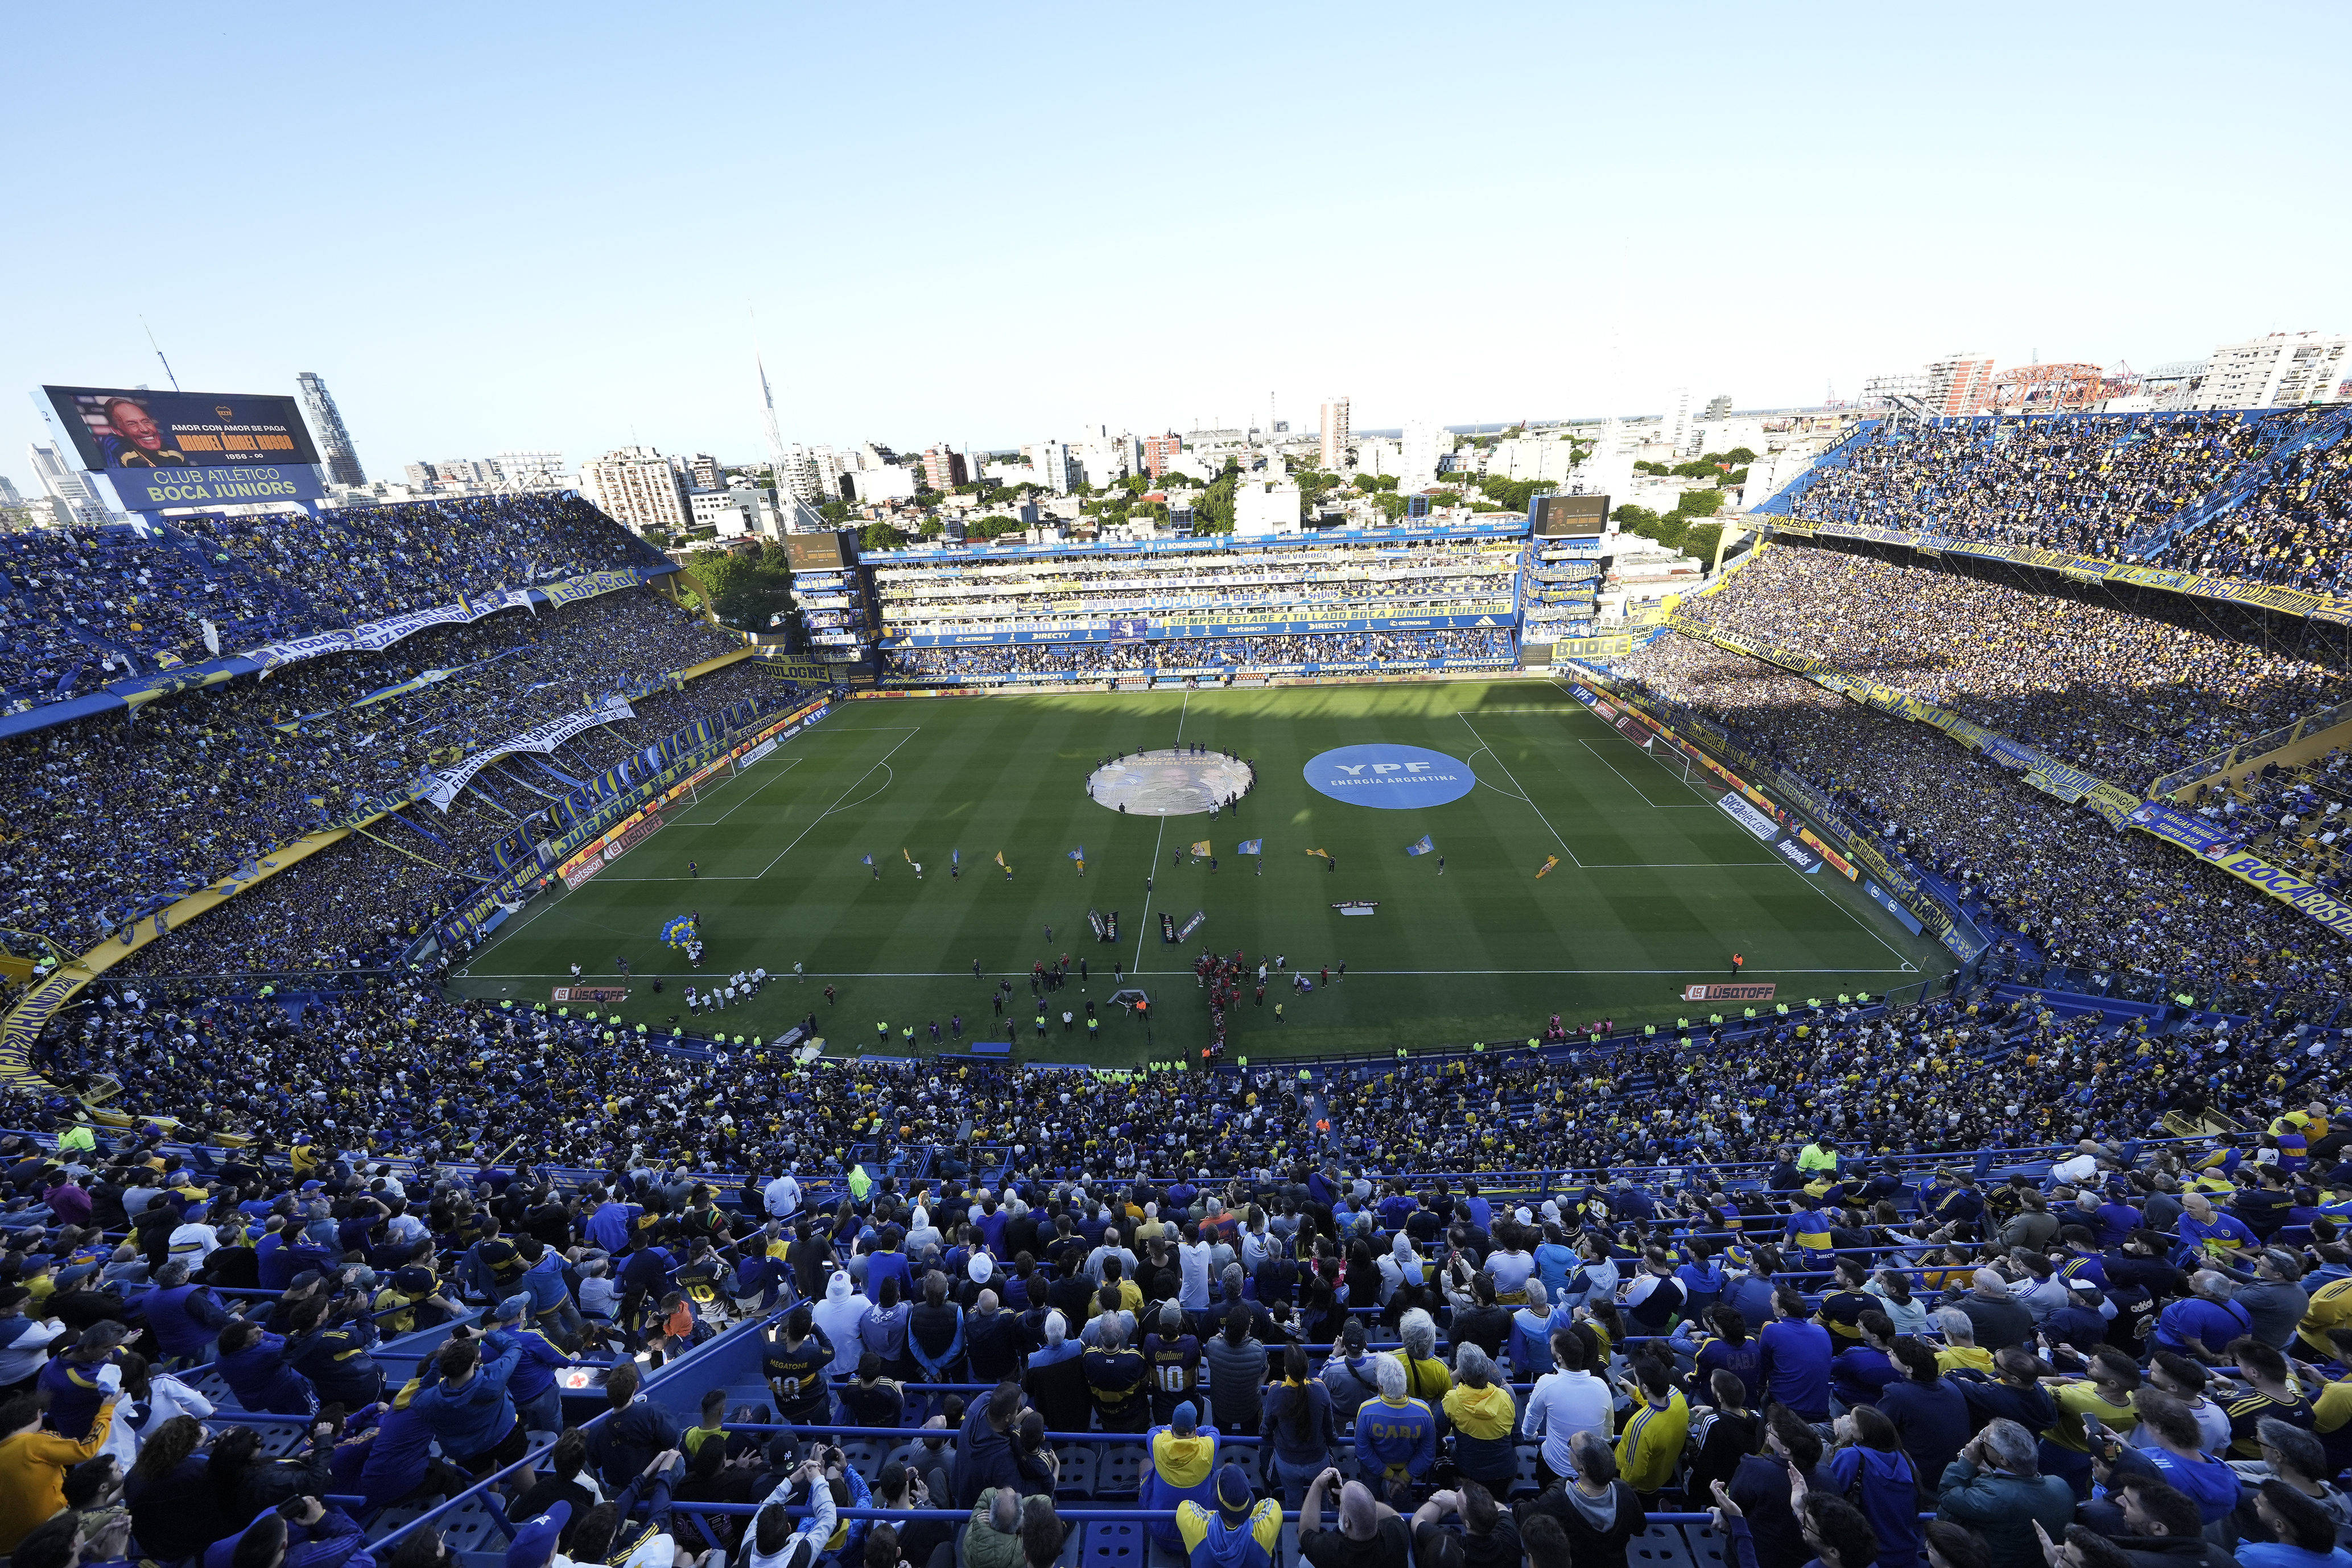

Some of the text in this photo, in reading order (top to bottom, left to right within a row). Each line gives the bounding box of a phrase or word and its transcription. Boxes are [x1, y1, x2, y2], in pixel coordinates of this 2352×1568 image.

[175, 432, 294, 451] MIGUEL ÁNGEL RUSSO
[153, 467, 280, 484] CLUB ATLÉTICO
[147, 481, 297, 502] BOCA JUNIORS
[1768, 517, 1791, 527] VIVA
[1791, 518, 1822, 531] BOCA
[1819, 523, 1864, 535] ENSENADA
[1867, 529, 1912, 544] LOS HORNOS
[1724, 551, 1752, 571] CAMPANA
[1141, 577, 1220, 587] CONTRA
[1268, 593, 1277, 601] LA
[1340, 583, 1512, 599] SOY BOSTERO
[1084, 600, 1111, 609] JUNTOS
[1129, 598, 1146, 606] BOCA
[1150, 596, 1212, 606] LEOPARDI
[1631, 600, 1661, 609] VERSAILLES
[1170, 616, 1224, 625] SIEMPRE
[1227, 613, 1274, 623] ESTARE
[1351, 610, 1385, 619] BOCA
[1389, 608, 1445, 617] JUNIORS
[1449, 605, 1505, 616] QUERIDO
[2310, 611, 2351, 626] PUEBLO
[891, 621, 1080, 636] BOCA UNICO BARRIO DE
[1632, 625, 1654, 634] FUNES
[1676, 617, 1711, 633] LIBERTADOR
[350, 633, 393, 650] FELIZ
[814, 635, 852, 644] LEOPARDI
[1632, 632, 1653, 641] CHACO
[1713, 629, 1731, 641] JOSE
[1740, 639, 1755, 650] PAZ
[1556, 638, 1628, 657] BUDGE
[1716, 639, 1746, 654] BRANDSEN
[789, 654, 811, 663] VISO
[756, 663, 828, 680] BOULOGNE
[1810, 661, 1872, 694] ANDERSON
[1573, 685, 1592, 700] YPF
[1629, 691, 1656, 708] LOMAS
[773, 705, 795, 721] MIGUEL
[808, 706, 828, 722] YPF
[810, 700, 822, 712] Quini
[1595, 702, 1614, 720] betsson
[1870, 699, 1909, 719] SOLANO
[531, 715, 577, 741] GRACIAS
[735, 716, 774, 740] LEOPARDI
[773, 721, 786, 732] Quini
[783, 724, 800, 739] Rotoplas
[453, 757, 487, 790] FUERZA
[551, 718, 597, 746] JUGADOR
[1684, 744, 1698, 758] Quini
[1724, 742, 1751, 768] ESTO ES
[1334, 761, 1431, 775] YPF
[2033, 755, 2098, 793] SPEGAZZINI
[1331, 775, 1458, 786] ENERGÍA ARGENTINA
[1726, 774, 1749, 795] Quini 6
[558, 740, 727, 855] JUGADOR 12 PTE
[1777, 777, 1812, 808] PATERNAL
[1810, 803, 1848, 840] CALZADA
[2163, 812, 2188, 830] GRACIAS
[2156, 823, 2201, 846] SIEMPRE BOCA
[583, 834, 611, 859] Quini 6
[1850, 835, 1887, 876] CONTIGO SIEMPRE
[567, 857, 603, 886] betsson
[1827, 851, 1854, 878] Quini 6
[2229, 857, 2315, 900] BOCA
[448, 861, 542, 940] LA BARRA BOCA
[687, 1286, 715, 1302] 10
[2130, 1301, 2154, 1313] adidas
[770, 1359, 808, 1369] MEGATONE
[1155, 1350, 1183, 1361] Quilmes
[1727, 1352, 1758, 1371] CABJ
[771, 1377, 800, 1396] 10
[1157, 1367, 1183, 1392] 10
[1372, 1423, 1422, 1440] CABJ
